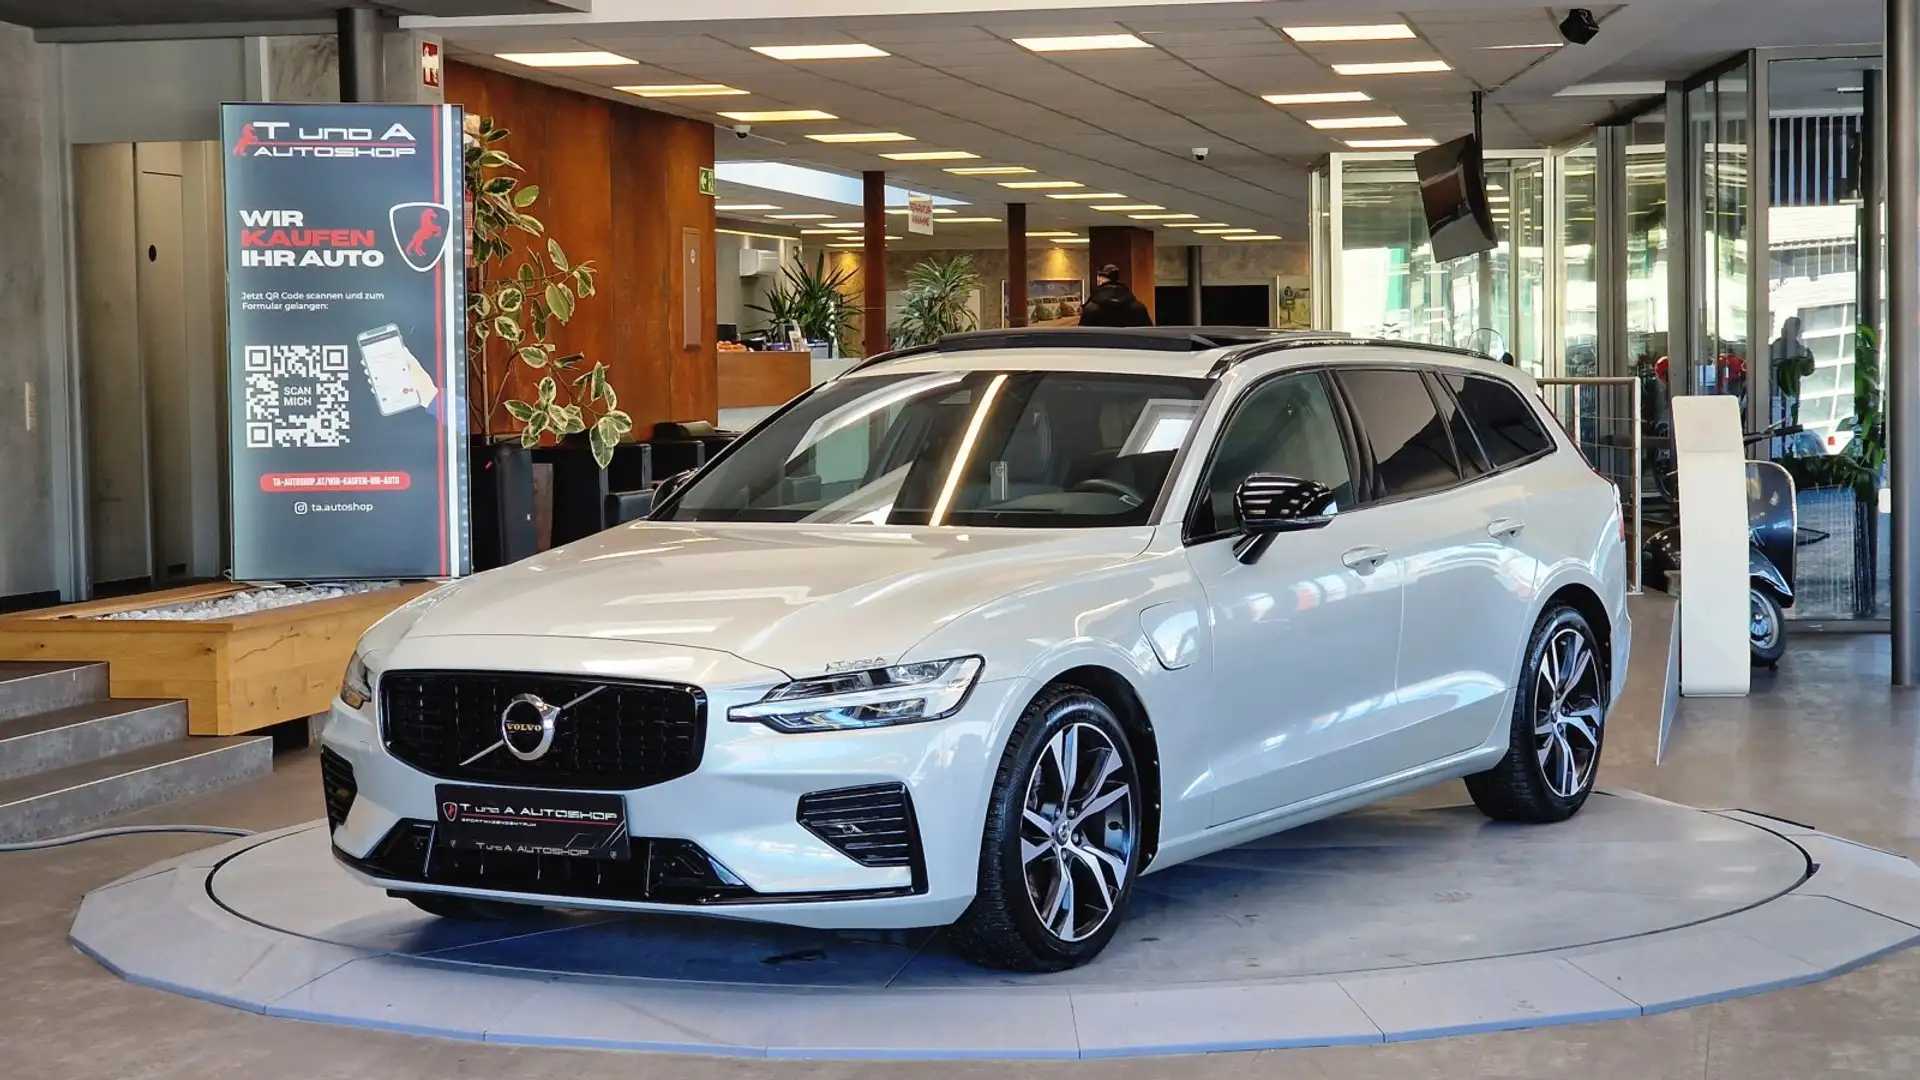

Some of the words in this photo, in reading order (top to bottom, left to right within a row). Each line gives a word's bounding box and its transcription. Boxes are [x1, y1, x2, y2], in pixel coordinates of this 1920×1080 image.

[253, 121, 290, 140] T
[380, 123, 415, 141] A
[253, 146, 416, 158] AUTOSHOP
[239, 210, 303, 227] WIR
[241, 229, 375, 247] KAUFEN
[241, 250, 296, 267] IHR
[299, 250, 385, 267] AUTO
[241, 291, 264, 300] Jetzt
[265, 291, 279, 301] QR
[281, 291, 304, 300] Code
[306, 292, 343, 300] scannen
[345, 291, 363, 300] und
[364, 292, 384, 300] zum
[242, 301, 283, 310] Formular
[284, 301, 329, 312] gelangen:
[283, 386, 312, 396] SCAN
[283, 396, 312, 406] MICH
[311, 502, 374, 514] ta.autoshop
[506, 723, 542, 732] VOLVO
[459, 803, 472, 812] T
[503, 806, 515, 815] A
[520, 808, 618, 821] AUTOSHOP
[504, 843, 513, 852] A
[517, 846, 590, 857] AUTOSHOP
